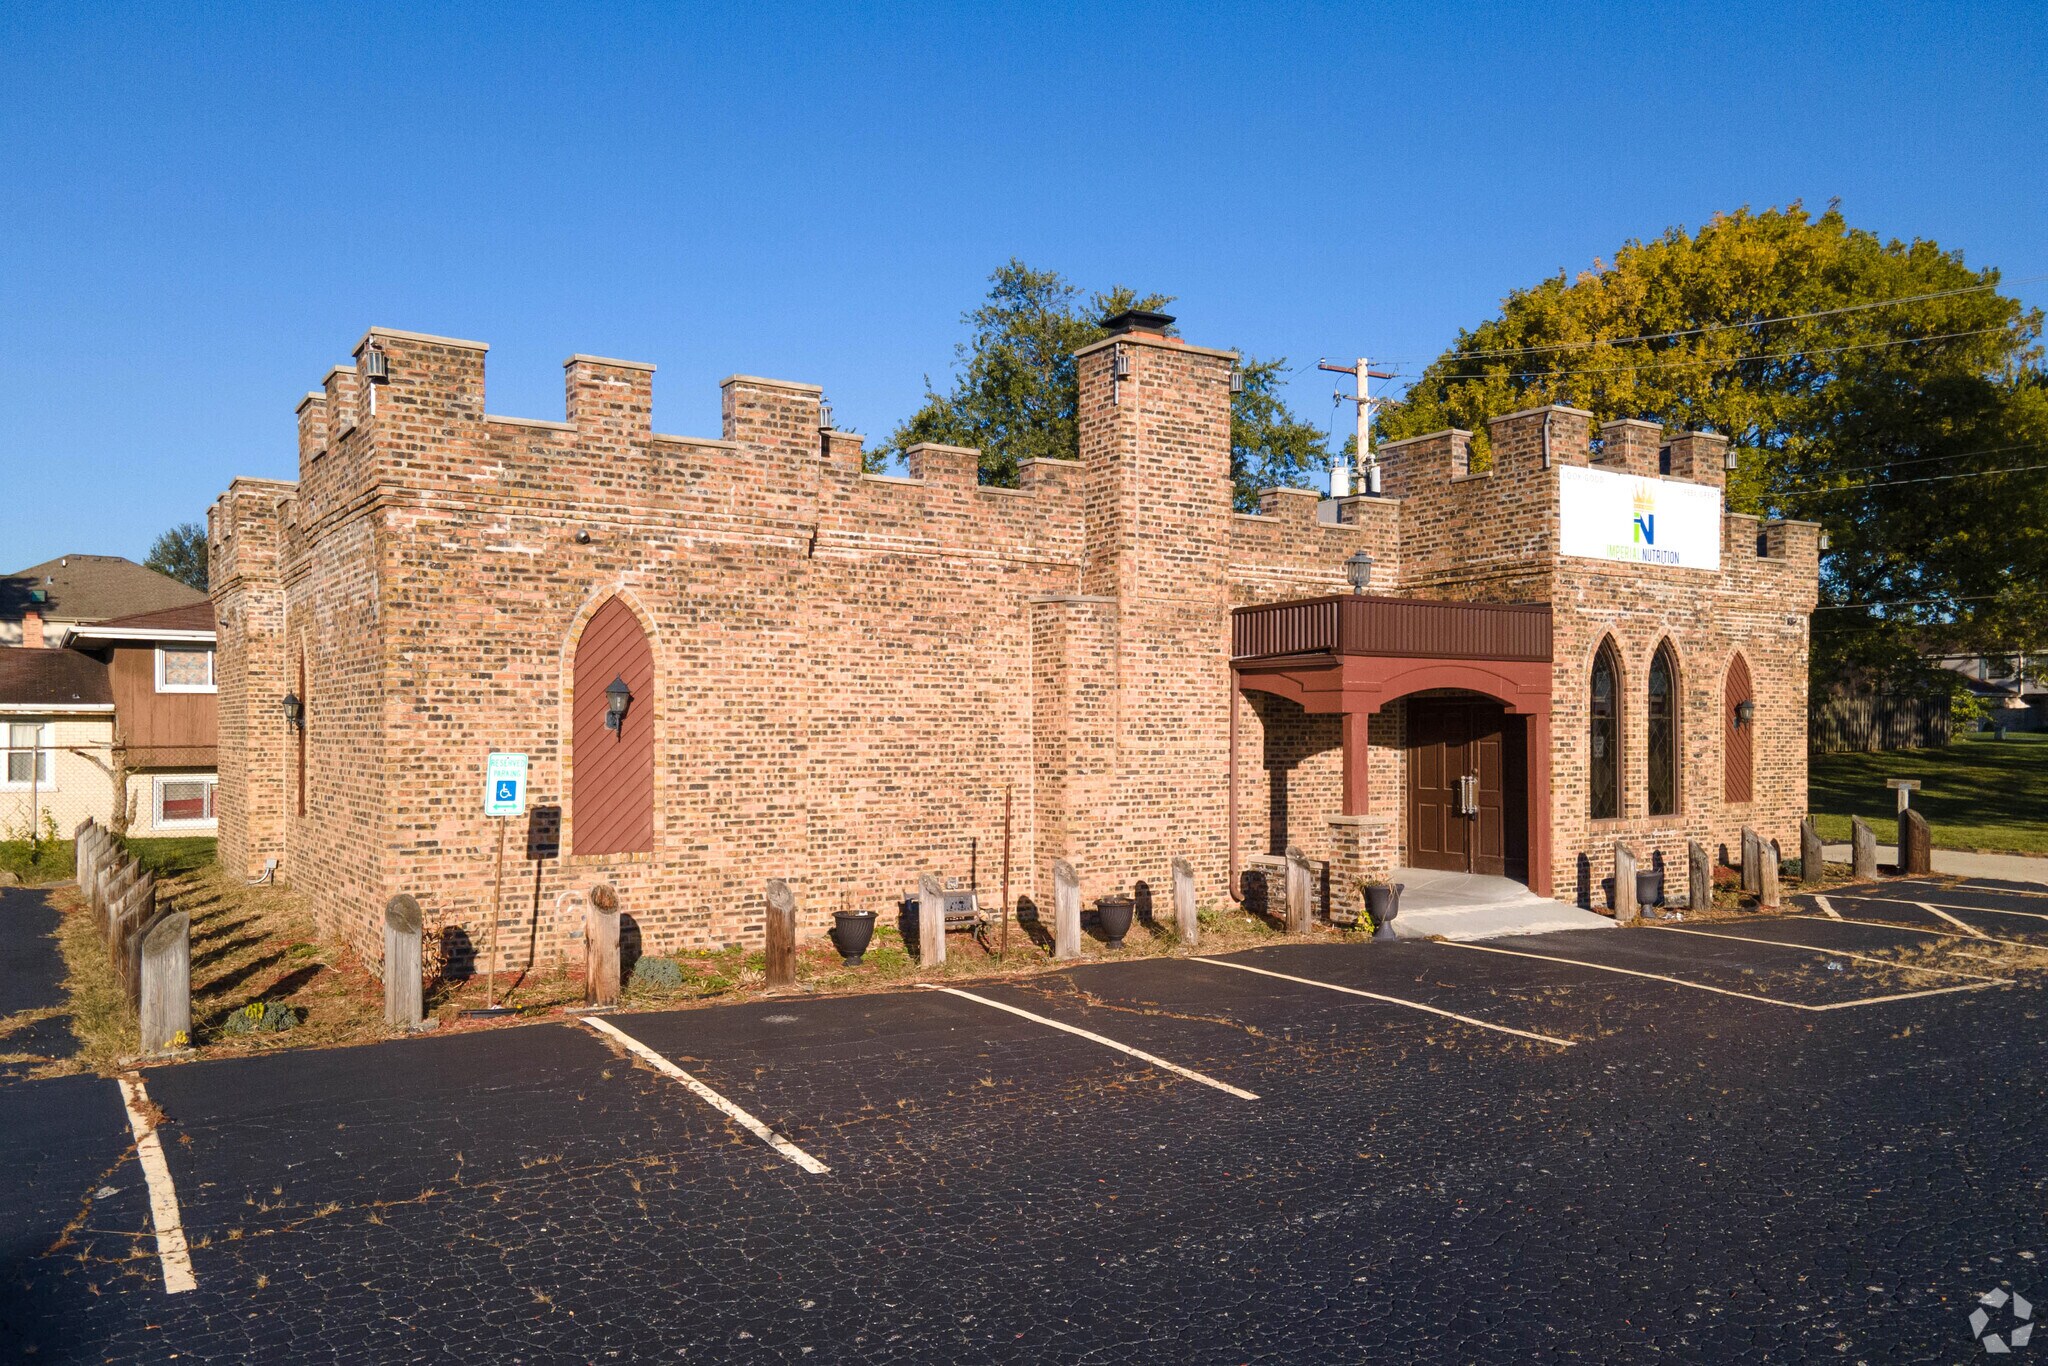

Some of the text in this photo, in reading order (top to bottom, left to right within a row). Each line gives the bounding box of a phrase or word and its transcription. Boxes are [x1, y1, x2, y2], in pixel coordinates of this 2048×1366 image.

[1606, 544, 1679, 564] IMPERIAL NUTRITION
[490, 759, 525, 767] RESERVED
